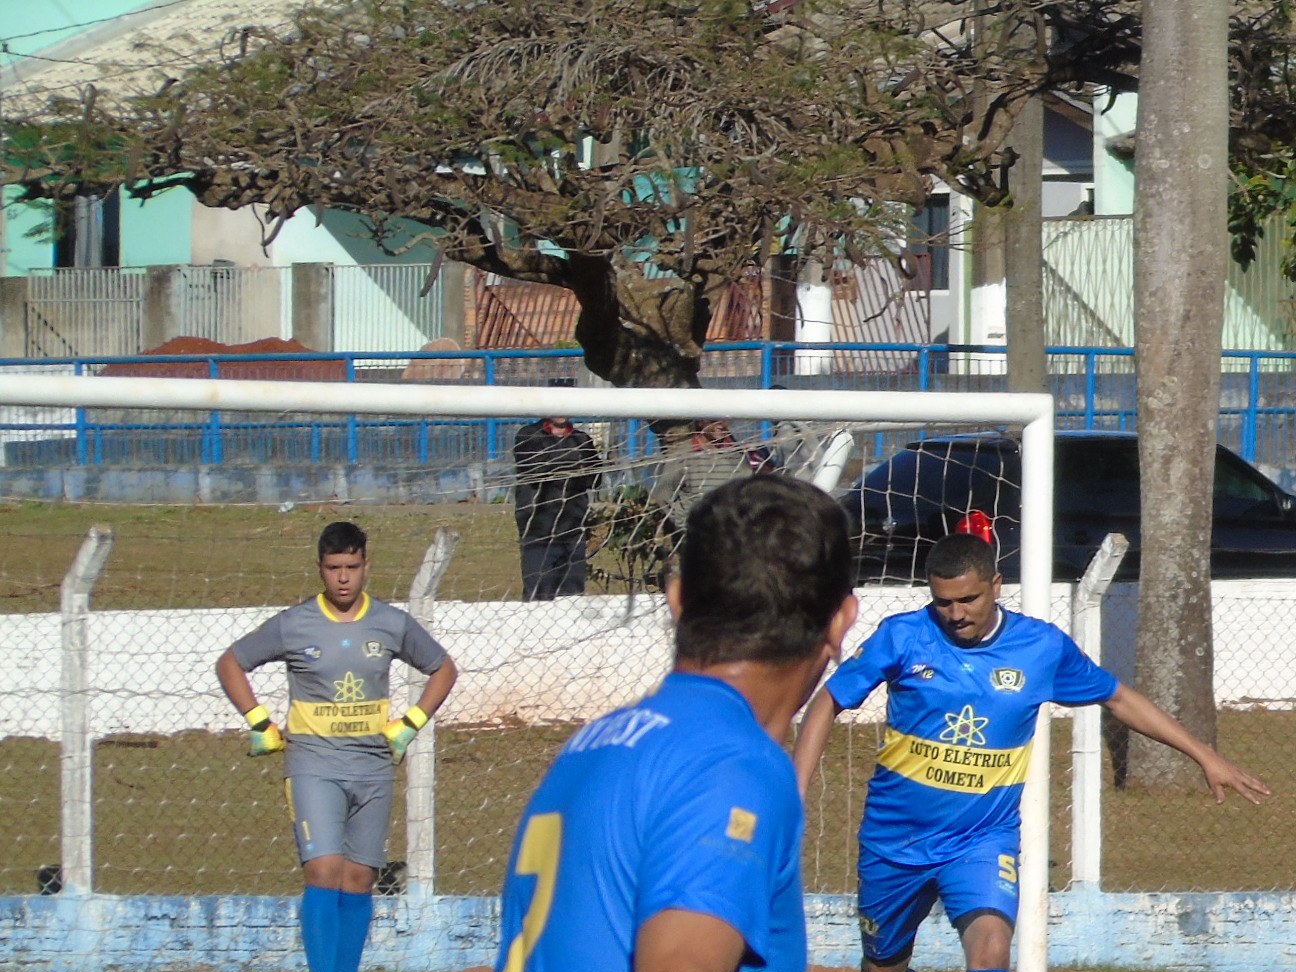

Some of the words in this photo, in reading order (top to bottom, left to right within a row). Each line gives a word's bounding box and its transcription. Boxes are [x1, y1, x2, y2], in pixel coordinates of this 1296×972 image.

[330, 721, 370, 733] COMETA
[943, 748, 1012, 768] ELÉTRICA
[926, 766, 985, 788] COMETA
